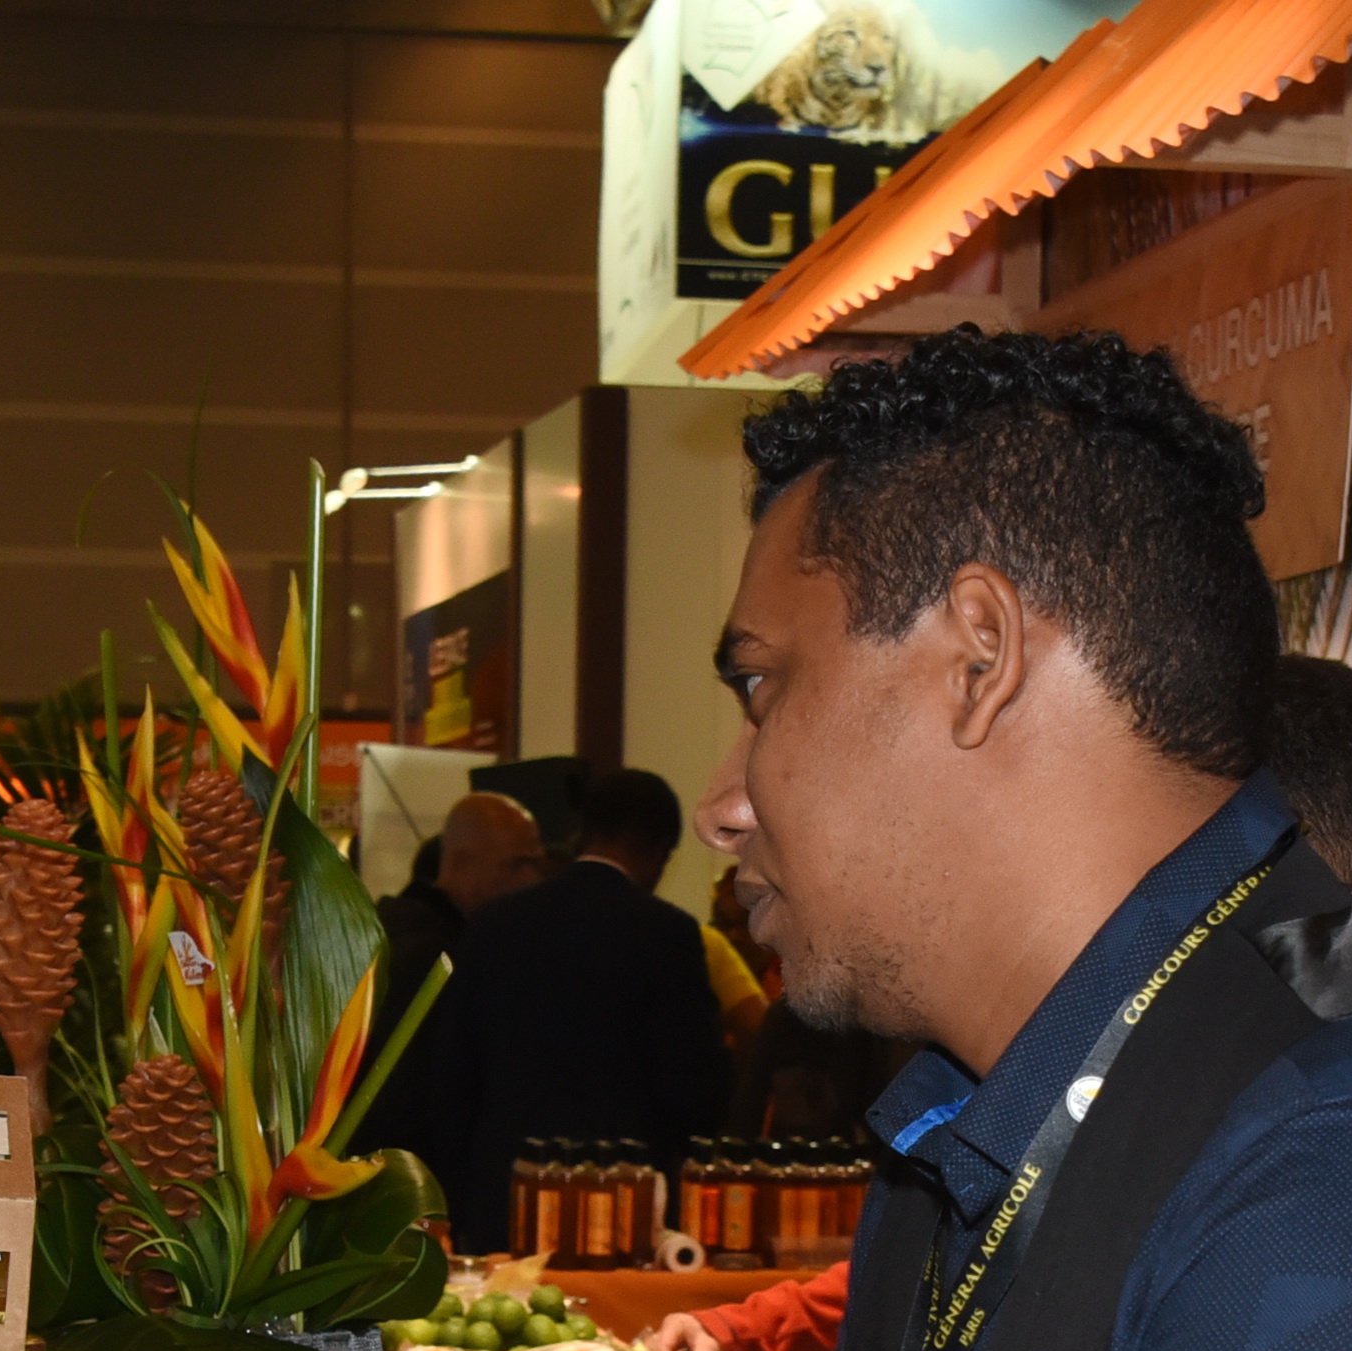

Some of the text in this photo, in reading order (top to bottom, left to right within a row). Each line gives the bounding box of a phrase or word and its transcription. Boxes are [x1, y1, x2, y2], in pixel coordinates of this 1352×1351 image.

[1122, 924, 1212, 1026] CONCOURS
[933, 1260, 987, 1351] GÉNÉRAL
[980, 1161, 1044, 1261] AGRICOLE
[958, 1307, 987, 1348] PARIS
